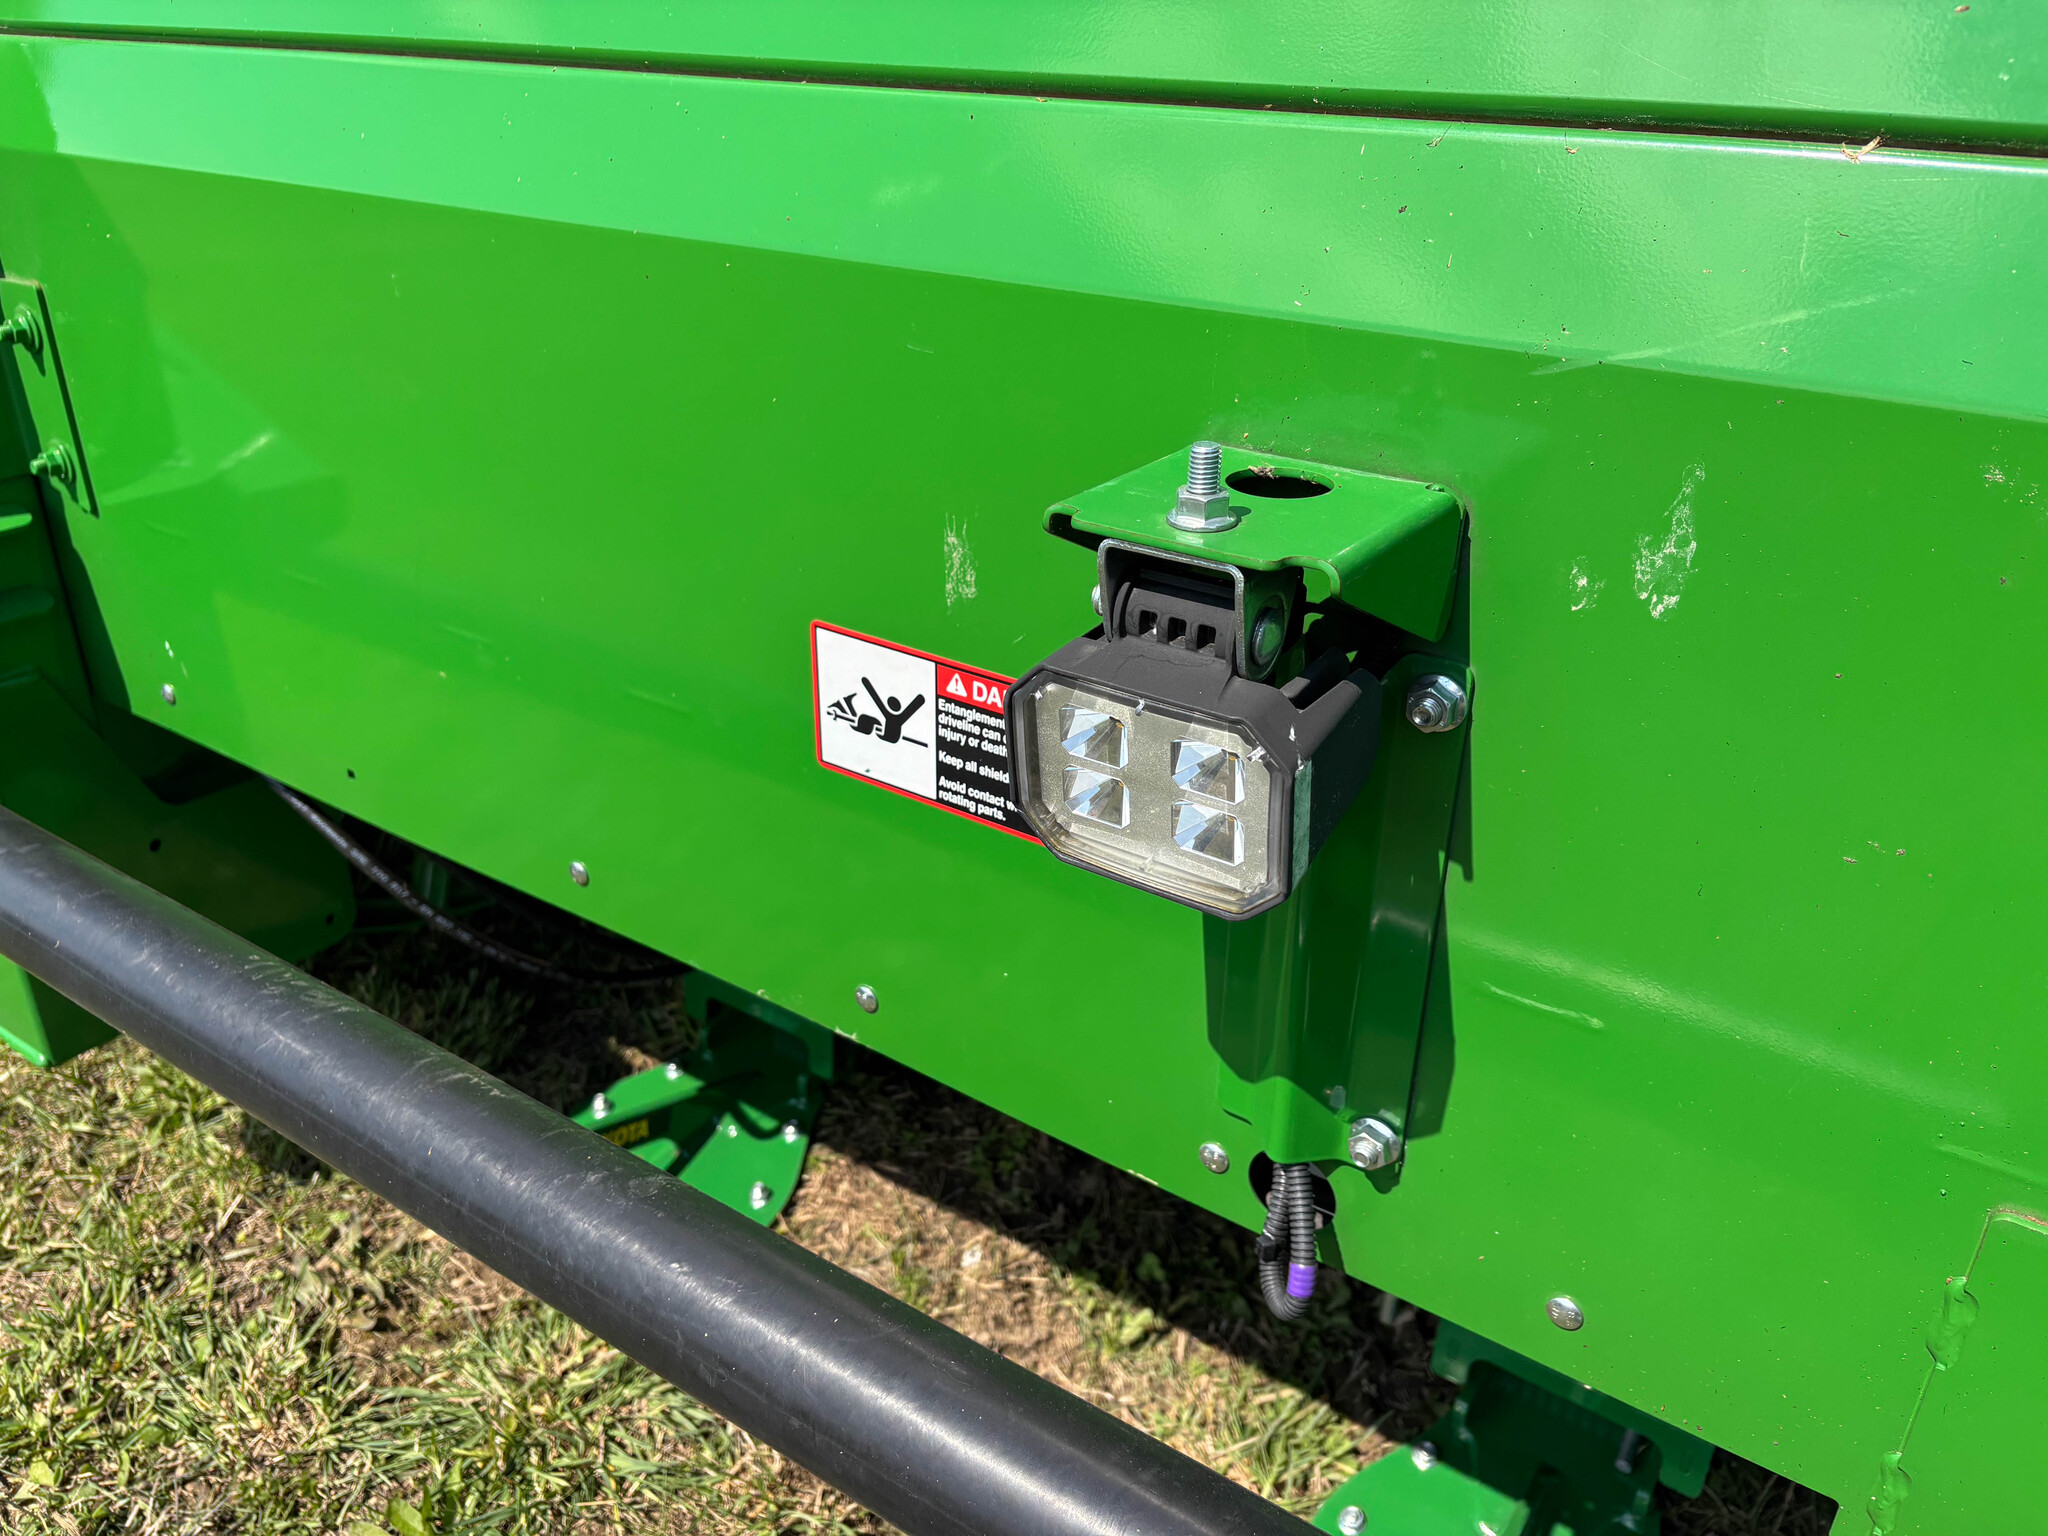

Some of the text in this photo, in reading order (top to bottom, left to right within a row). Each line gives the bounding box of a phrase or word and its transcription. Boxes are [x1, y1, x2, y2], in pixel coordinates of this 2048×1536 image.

[972, 680, 1007, 708] DA
[938, 712, 980, 735] driveline
[982, 728, 1001, 742] can
[938, 724, 967, 746] injury
[968, 737, 980, 748] or
[981, 739, 1008, 758] death
[938, 750, 964, 770] Keep
[965, 760, 977, 773] all
[938, 775, 966, 794] Avoid
[967, 787, 1005, 808] contact
[938, 790, 1006, 821] rotating parts.
